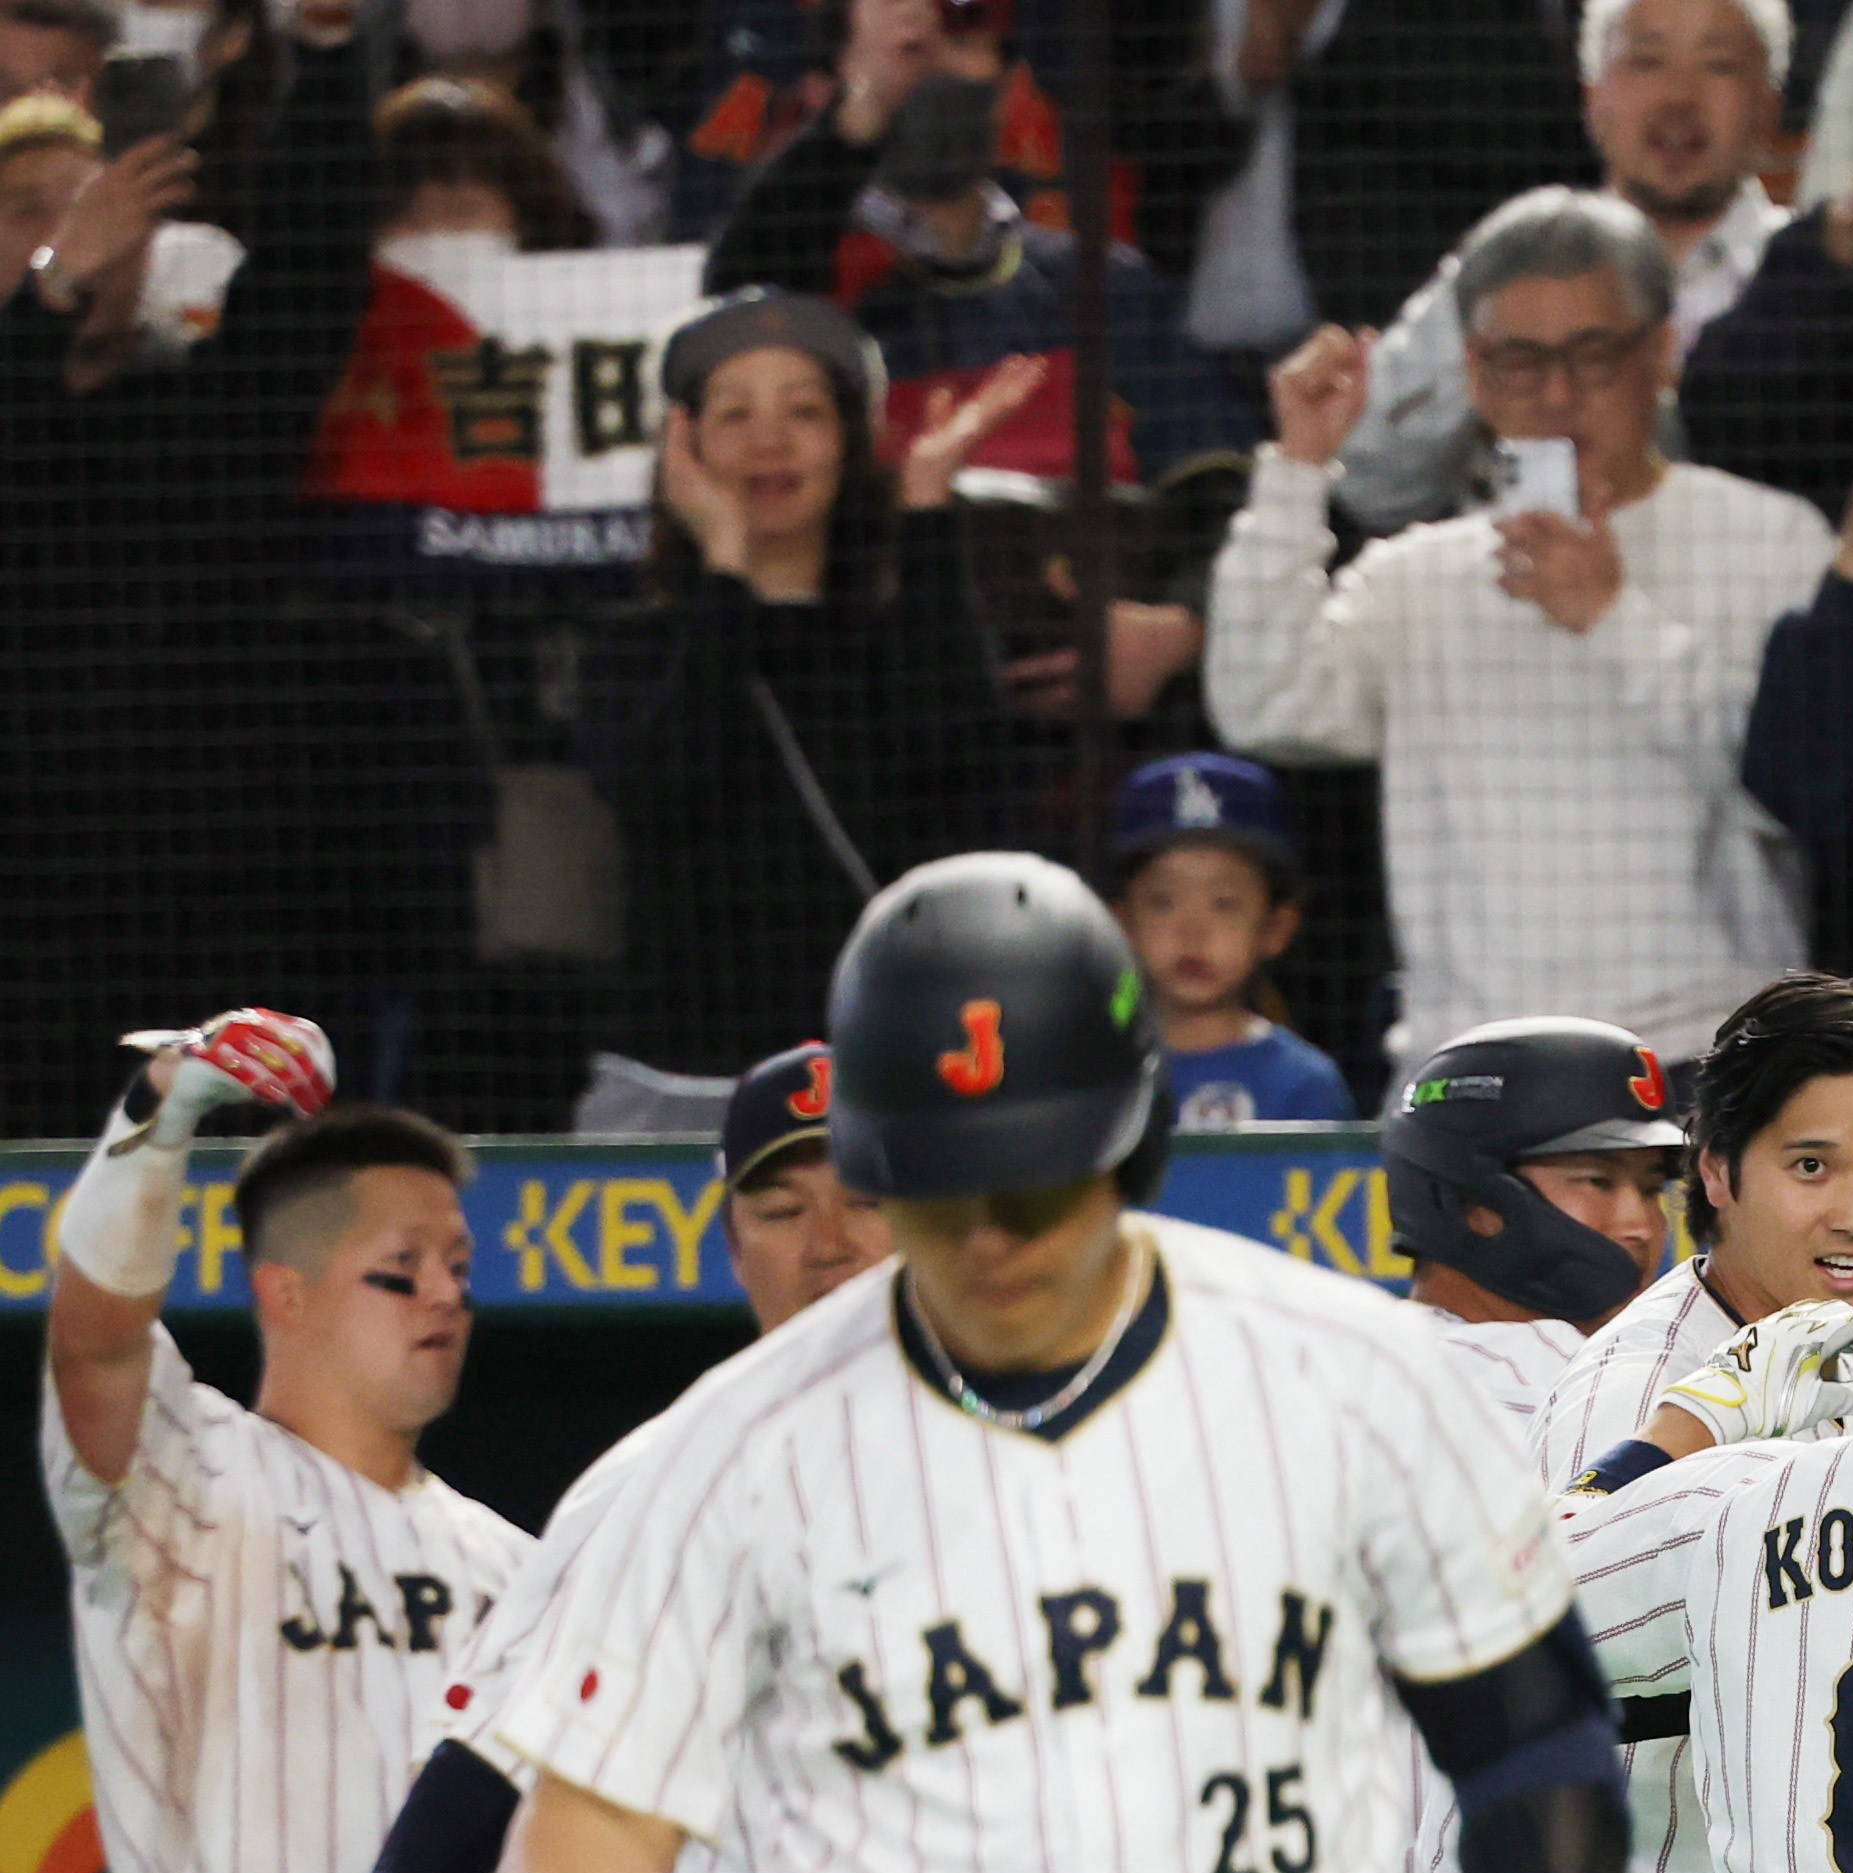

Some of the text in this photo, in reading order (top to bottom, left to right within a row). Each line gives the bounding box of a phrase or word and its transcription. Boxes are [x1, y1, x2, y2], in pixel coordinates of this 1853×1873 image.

[935, 999, 1004, 1097] J
[1628, 1045, 1665, 1111] J
[279, 1563, 496, 1653] JAP
[833, 1576, 1336, 1773] JAPAN
